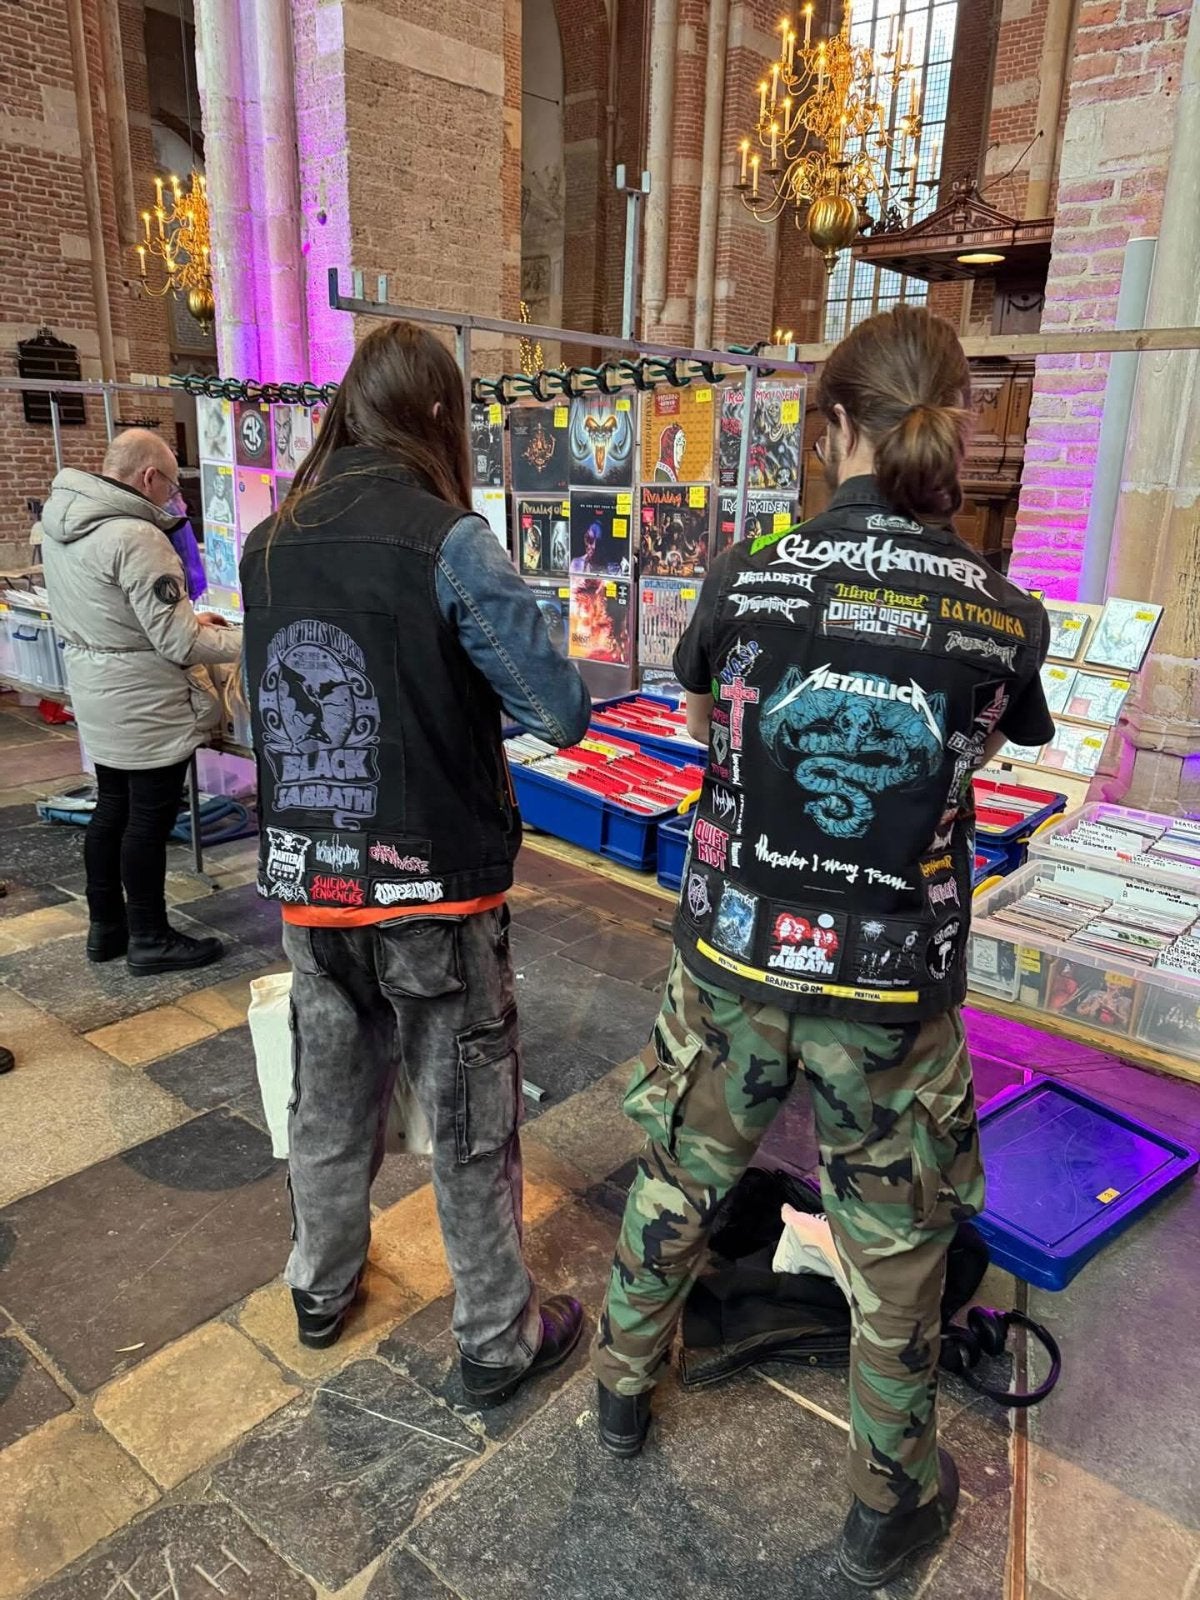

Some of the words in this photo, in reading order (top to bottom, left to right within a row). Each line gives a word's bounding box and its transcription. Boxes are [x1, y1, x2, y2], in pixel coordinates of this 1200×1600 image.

[748, 500, 790, 517] MAIDEN
[768, 533, 998, 602] GLORYHAMMER
[732, 570, 818, 593] MEGADETH
[828, 601, 876, 621] DIGGY
[878, 608, 928, 632] DIGGY
[853, 619, 898, 636] HOLE
[940, 597, 1025, 638] БАТЮШКА
[766, 662, 945, 750] METALLICA
[281, 749, 371, 782] BLACK
[277, 785, 373, 812] SABBATH
[694, 818, 730, 850] QUIET
[270, 848, 306, 872] PANTERA
[697, 843, 727, 872] RIOT
[313, 874, 362, 891] SUICIDAL
[374, 880, 444, 904] DOPELORD
[310, 886, 366, 906] TENDENCIES
[767, 955, 835, 975] SABBATH
[779, 944, 829, 963] BLACK
[1160, 958, 1183, 969] BLACK
[717, 956, 740, 972] FESTIVAL
[854, 990, 882, 1001] FESTIVAL
